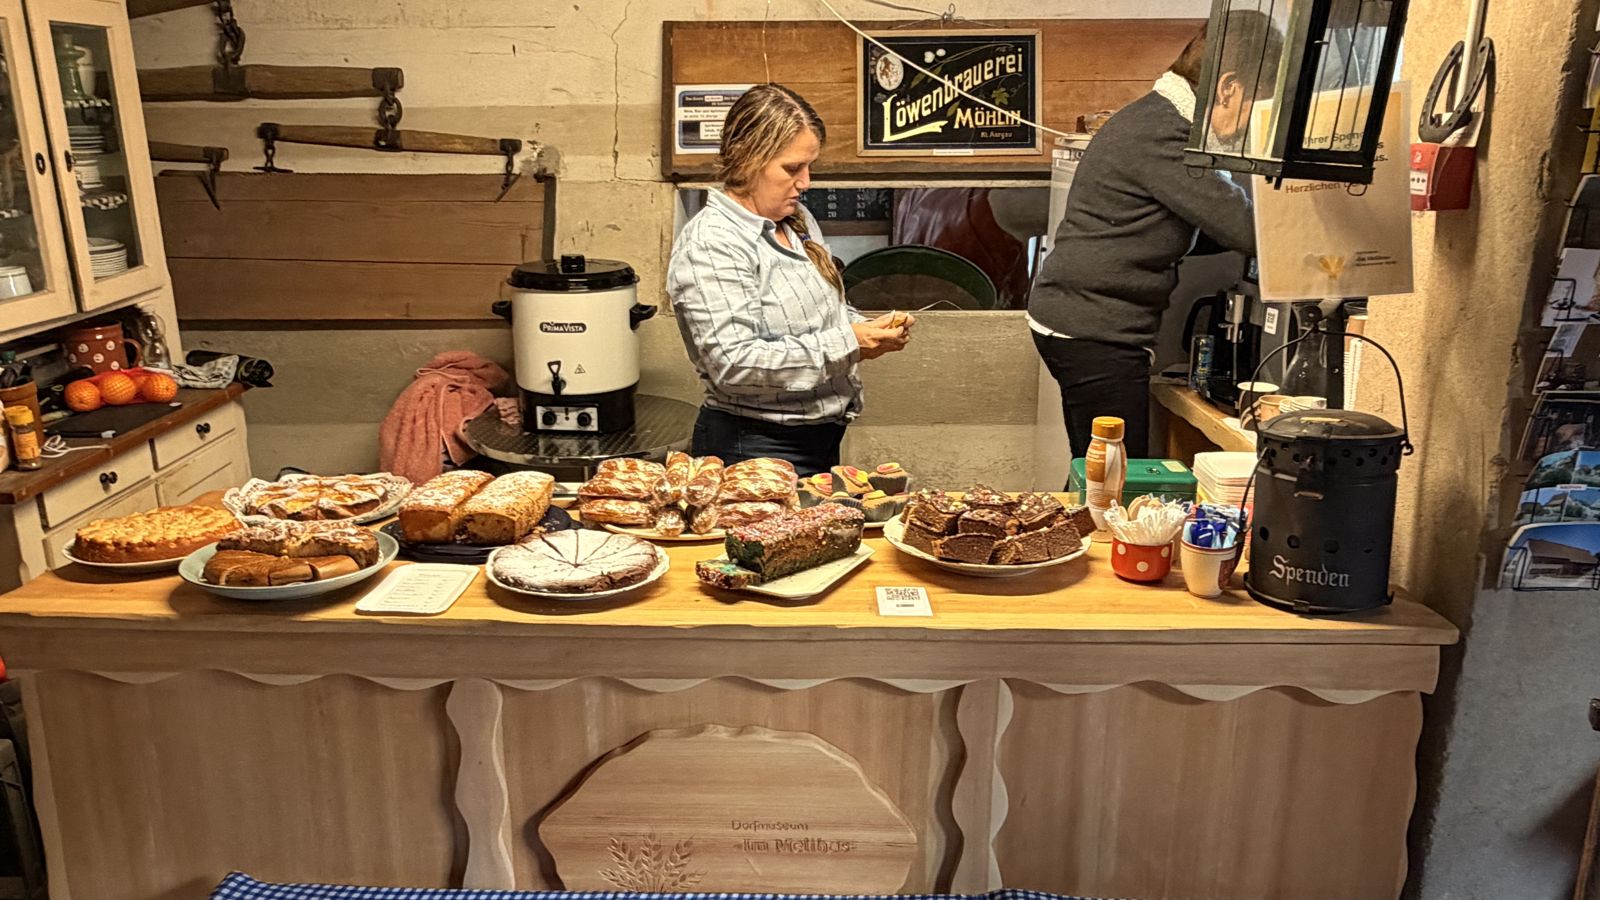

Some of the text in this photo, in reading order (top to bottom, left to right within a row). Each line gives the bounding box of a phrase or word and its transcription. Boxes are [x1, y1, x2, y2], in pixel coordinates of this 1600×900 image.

[882, 48, 1023, 142] Löwenbrauerei
[954, 107, 1021, 129] MÖHLIN
[1286, 181, 1341, 194] Herzlichen
[1269, 554, 1350, 587] Spenden
[731, 820, 809, 832] Dorfmuseum
